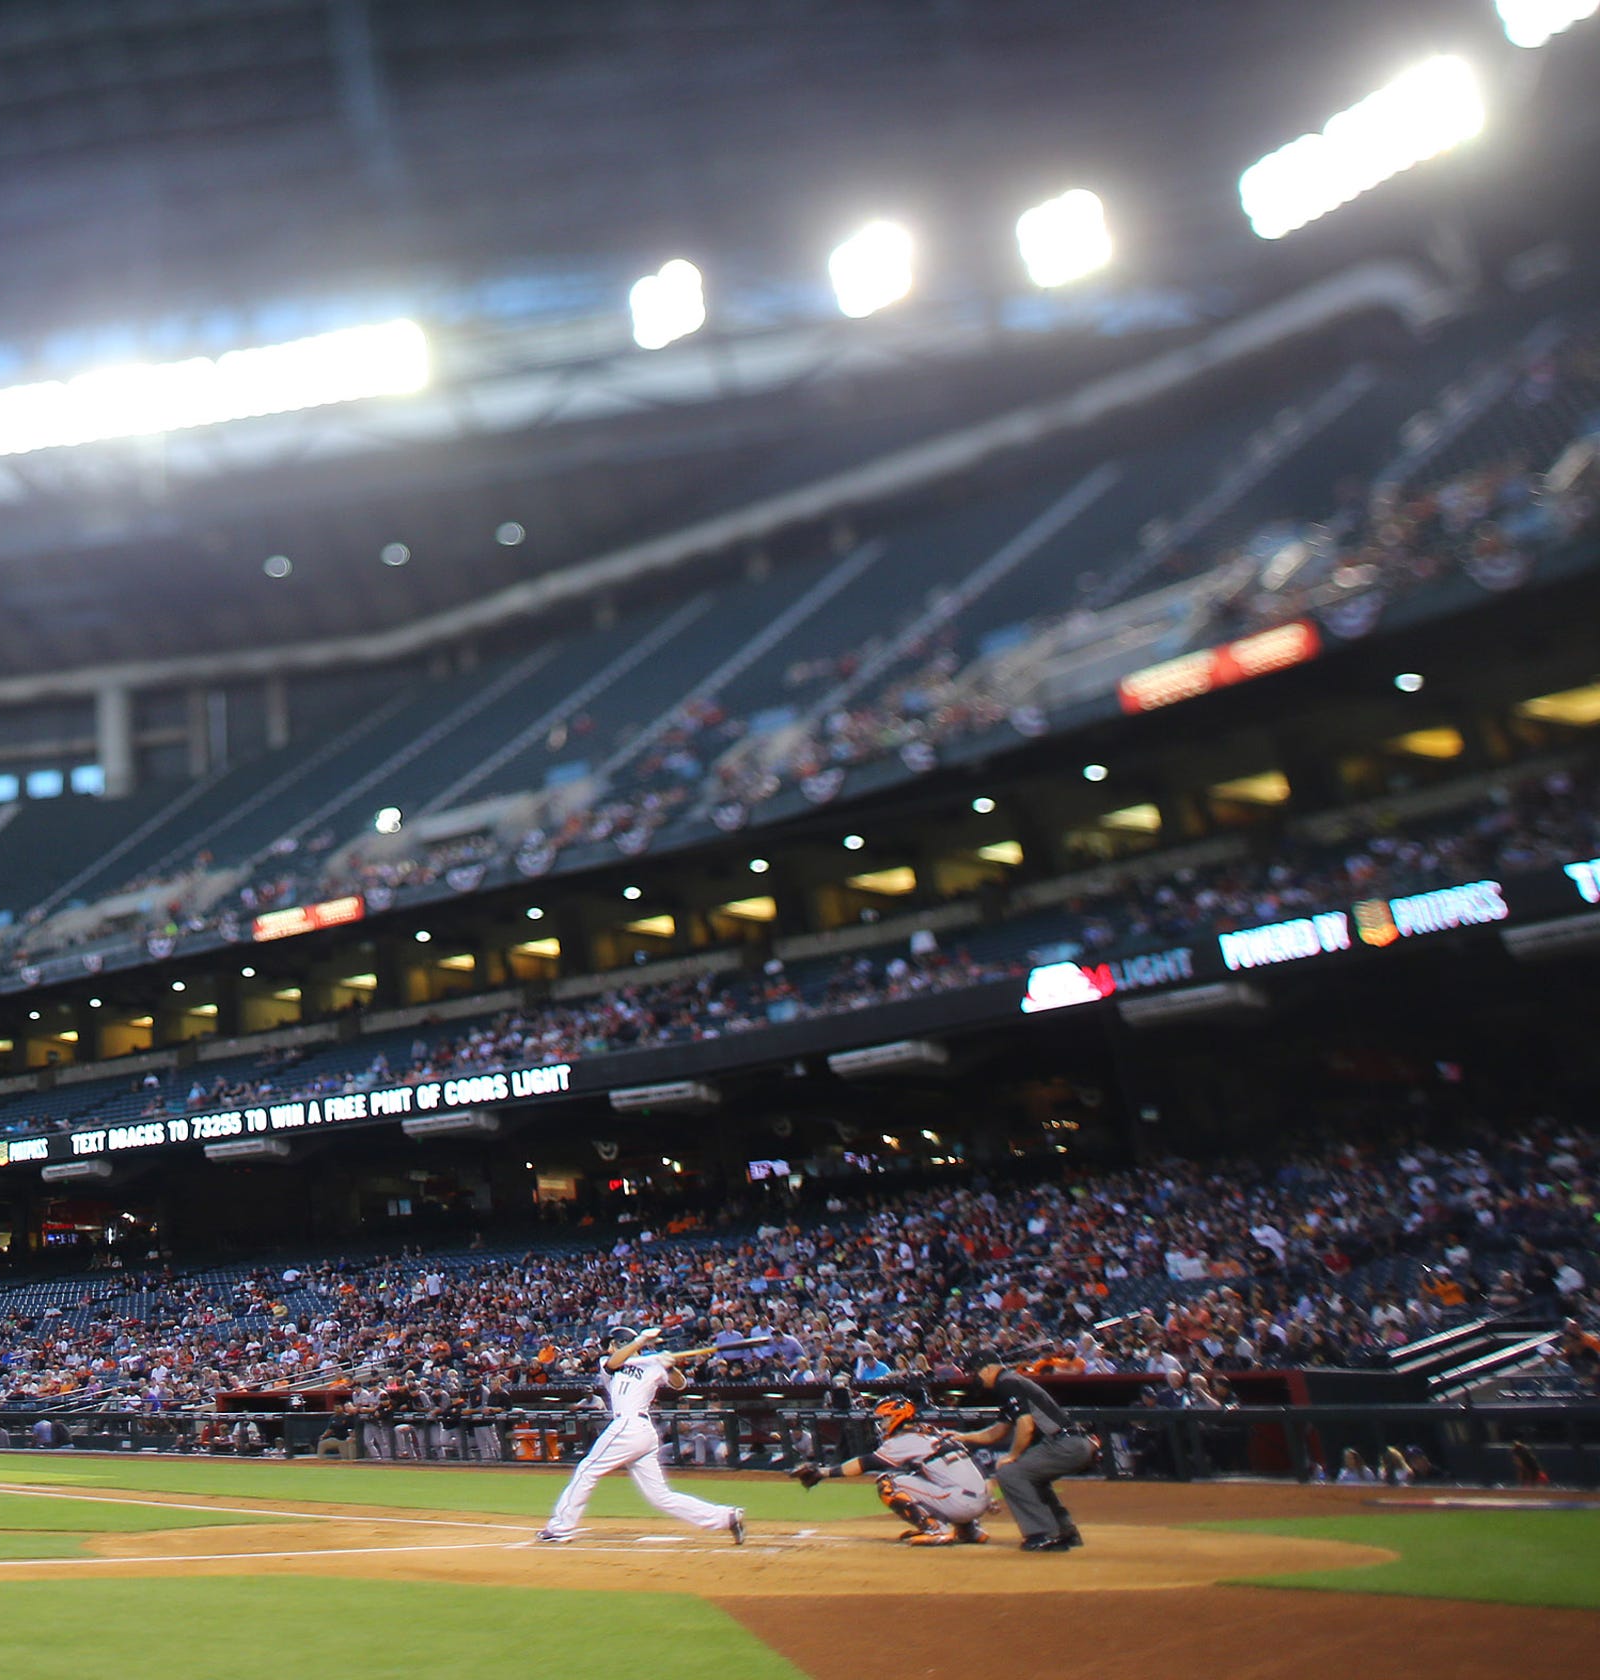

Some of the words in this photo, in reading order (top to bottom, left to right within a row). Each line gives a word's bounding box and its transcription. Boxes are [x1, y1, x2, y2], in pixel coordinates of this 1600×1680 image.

[1109, 948, 1193, 991] LIGHT
[71, 1130, 106, 1155] TEXT
[108, 1123, 166, 1151] DBACKS
[167, 1118, 189, 1143] TO
[191, 1111, 242, 1140] 73255
[245, 1107, 268, 1133] TO
[269, 1102, 305, 1129] WIN
[307, 1099, 322, 1124] A
[324, 1093, 368, 1123] FREE
[370, 1087, 413, 1117] PINT
[416, 1082, 441, 1110] OF
[444, 1073, 509, 1106] COORS
[511, 1064, 571, 1098] LIGHT
[619, 1381, 630, 1395] 11
